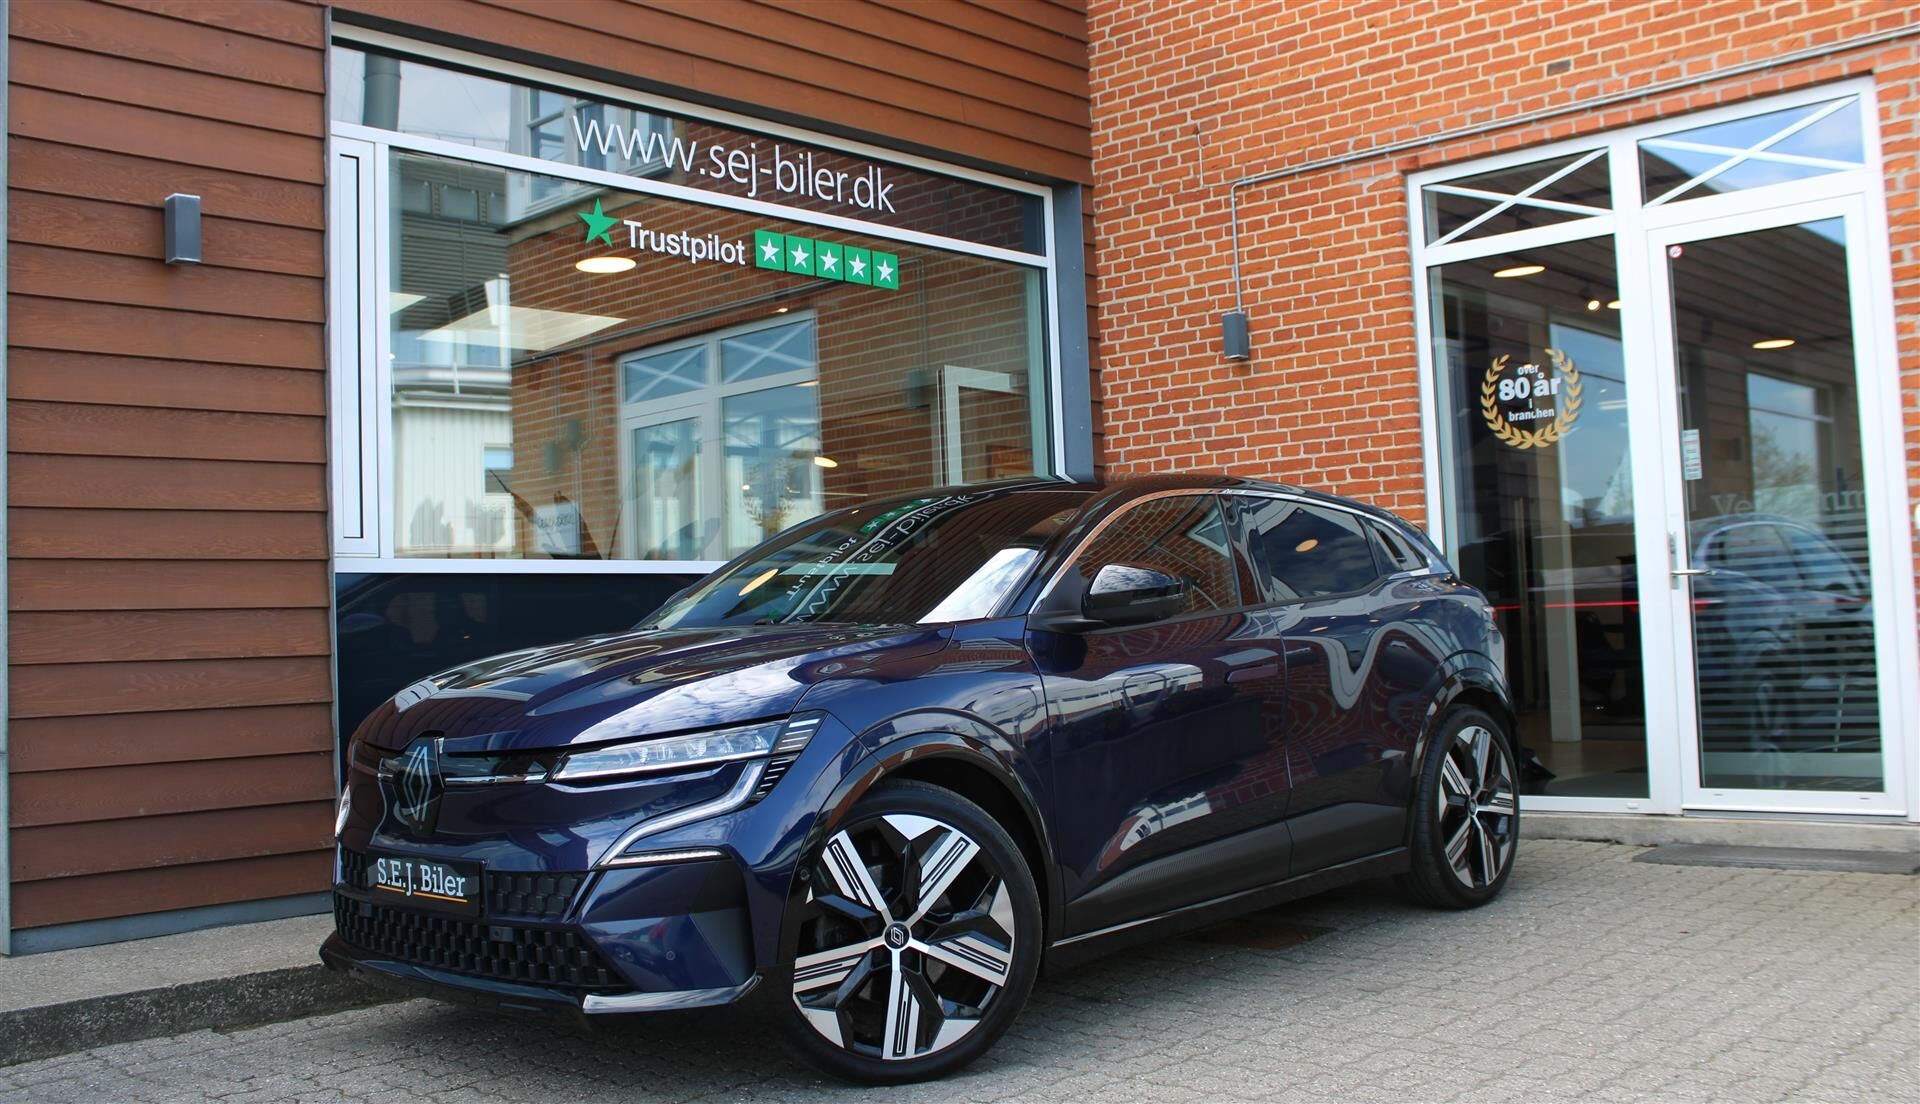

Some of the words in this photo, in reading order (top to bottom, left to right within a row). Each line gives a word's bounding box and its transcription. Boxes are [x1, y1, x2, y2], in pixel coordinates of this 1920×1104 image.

[573, 115, 896, 213] www.sej-biler.dk
[623, 219, 746, 266] Trustpilot
[1499, 377, 1531, 401] 80
[1533, 372, 1561, 397] år
[1517, 364, 1540, 376] over
[1508, 408, 1555, 422] branchen
[377, 858, 417, 896] S.E.J.
[420, 864, 466, 897] Biler
